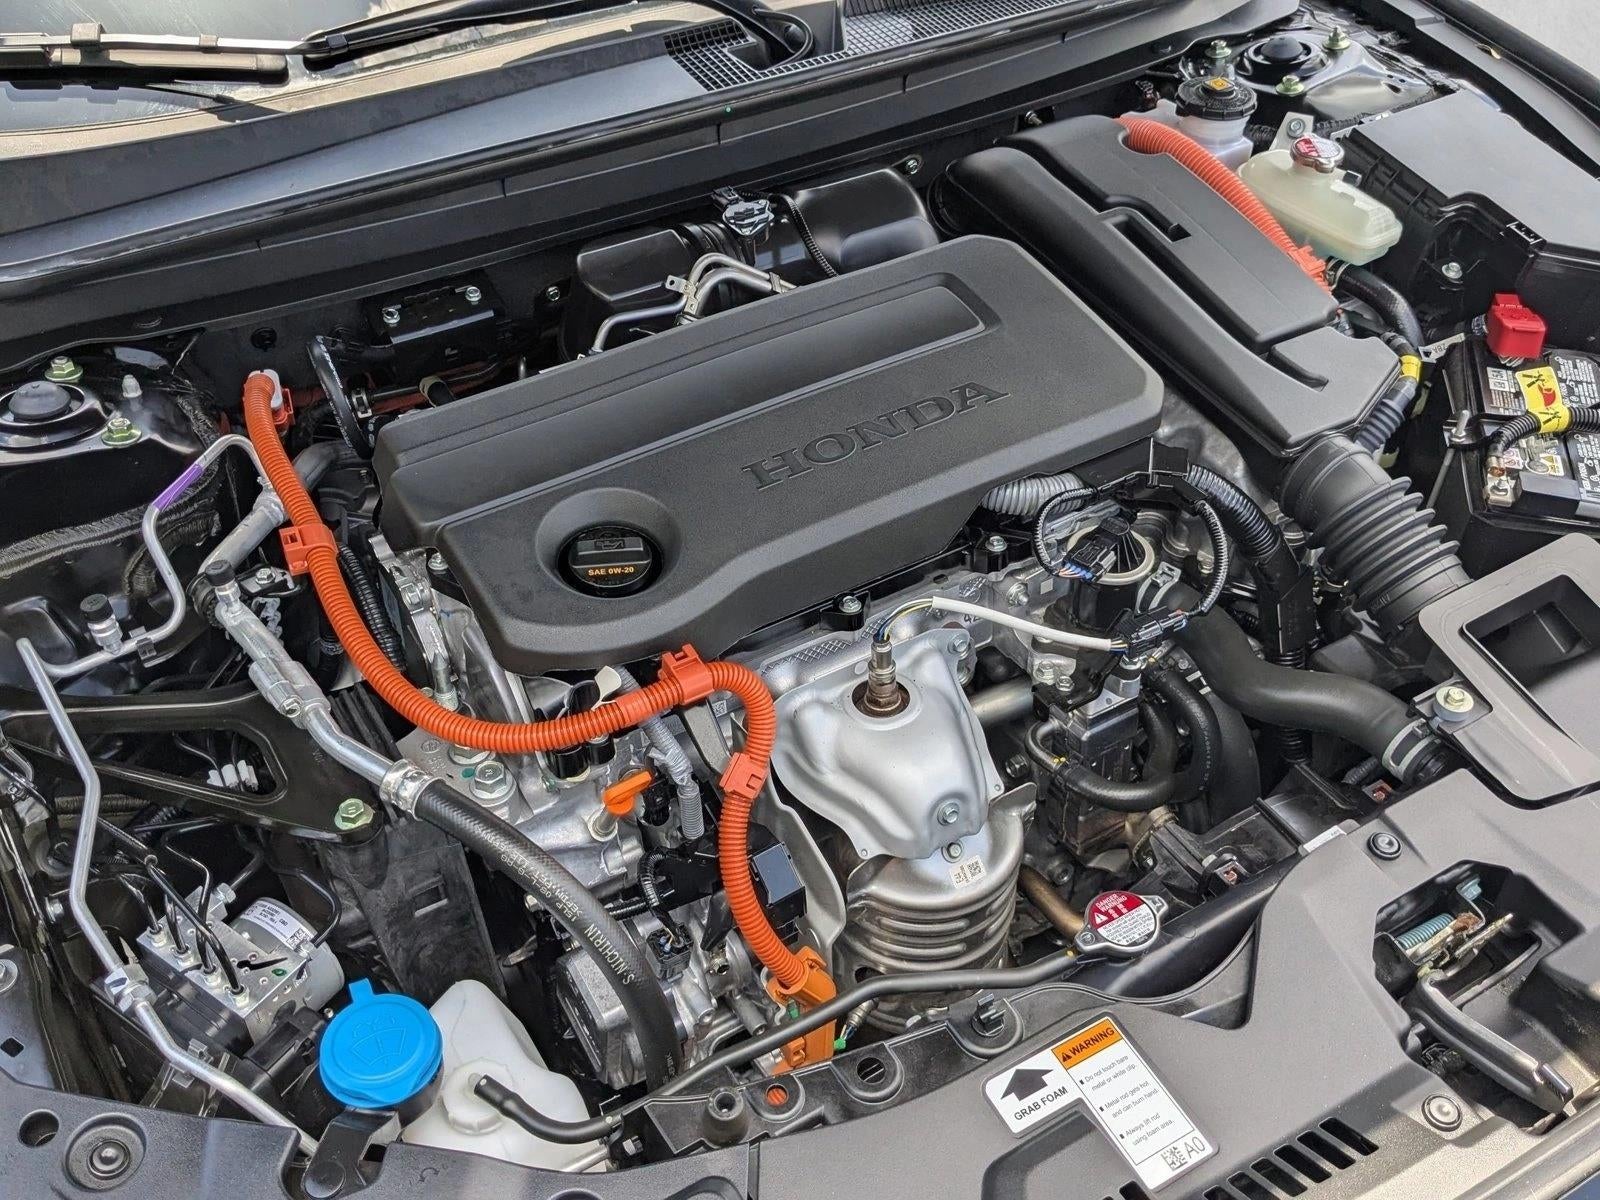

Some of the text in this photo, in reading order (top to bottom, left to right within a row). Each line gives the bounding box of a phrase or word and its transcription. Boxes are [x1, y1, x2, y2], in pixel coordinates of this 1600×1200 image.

[741, 381, 1011, 491] HONDA
[588, 566, 634, 576] SAE 0W-20
[1095, 893, 1119, 908] DANGER
[1069, 1027, 1115, 1056] WARNING
[1084, 1074, 1094, 1083] Do
[1102, 1062, 1117, 1073] touch
[1116, 1055, 1129, 1065] bare
[1092, 1080, 1107, 1091] metal
[1112, 1069, 1127, 1079] white
[1014, 1085, 1068, 1121] GRAB FOAM
[1104, 1096, 1120, 1109] Metal
[1119, 1092, 1129, 1100] rod
[1128, 1086, 1141, 1096] gets
[1112, 1109, 1123, 1119] and
[1122, 1103, 1132, 1112] can
[1132, 1096, 1145, 1107] burn
[1125, 1112, 1160, 1136] Always lift rod
[1133, 1134, 1148, 1146] using
[1146, 1126, 1160, 1138] foam
